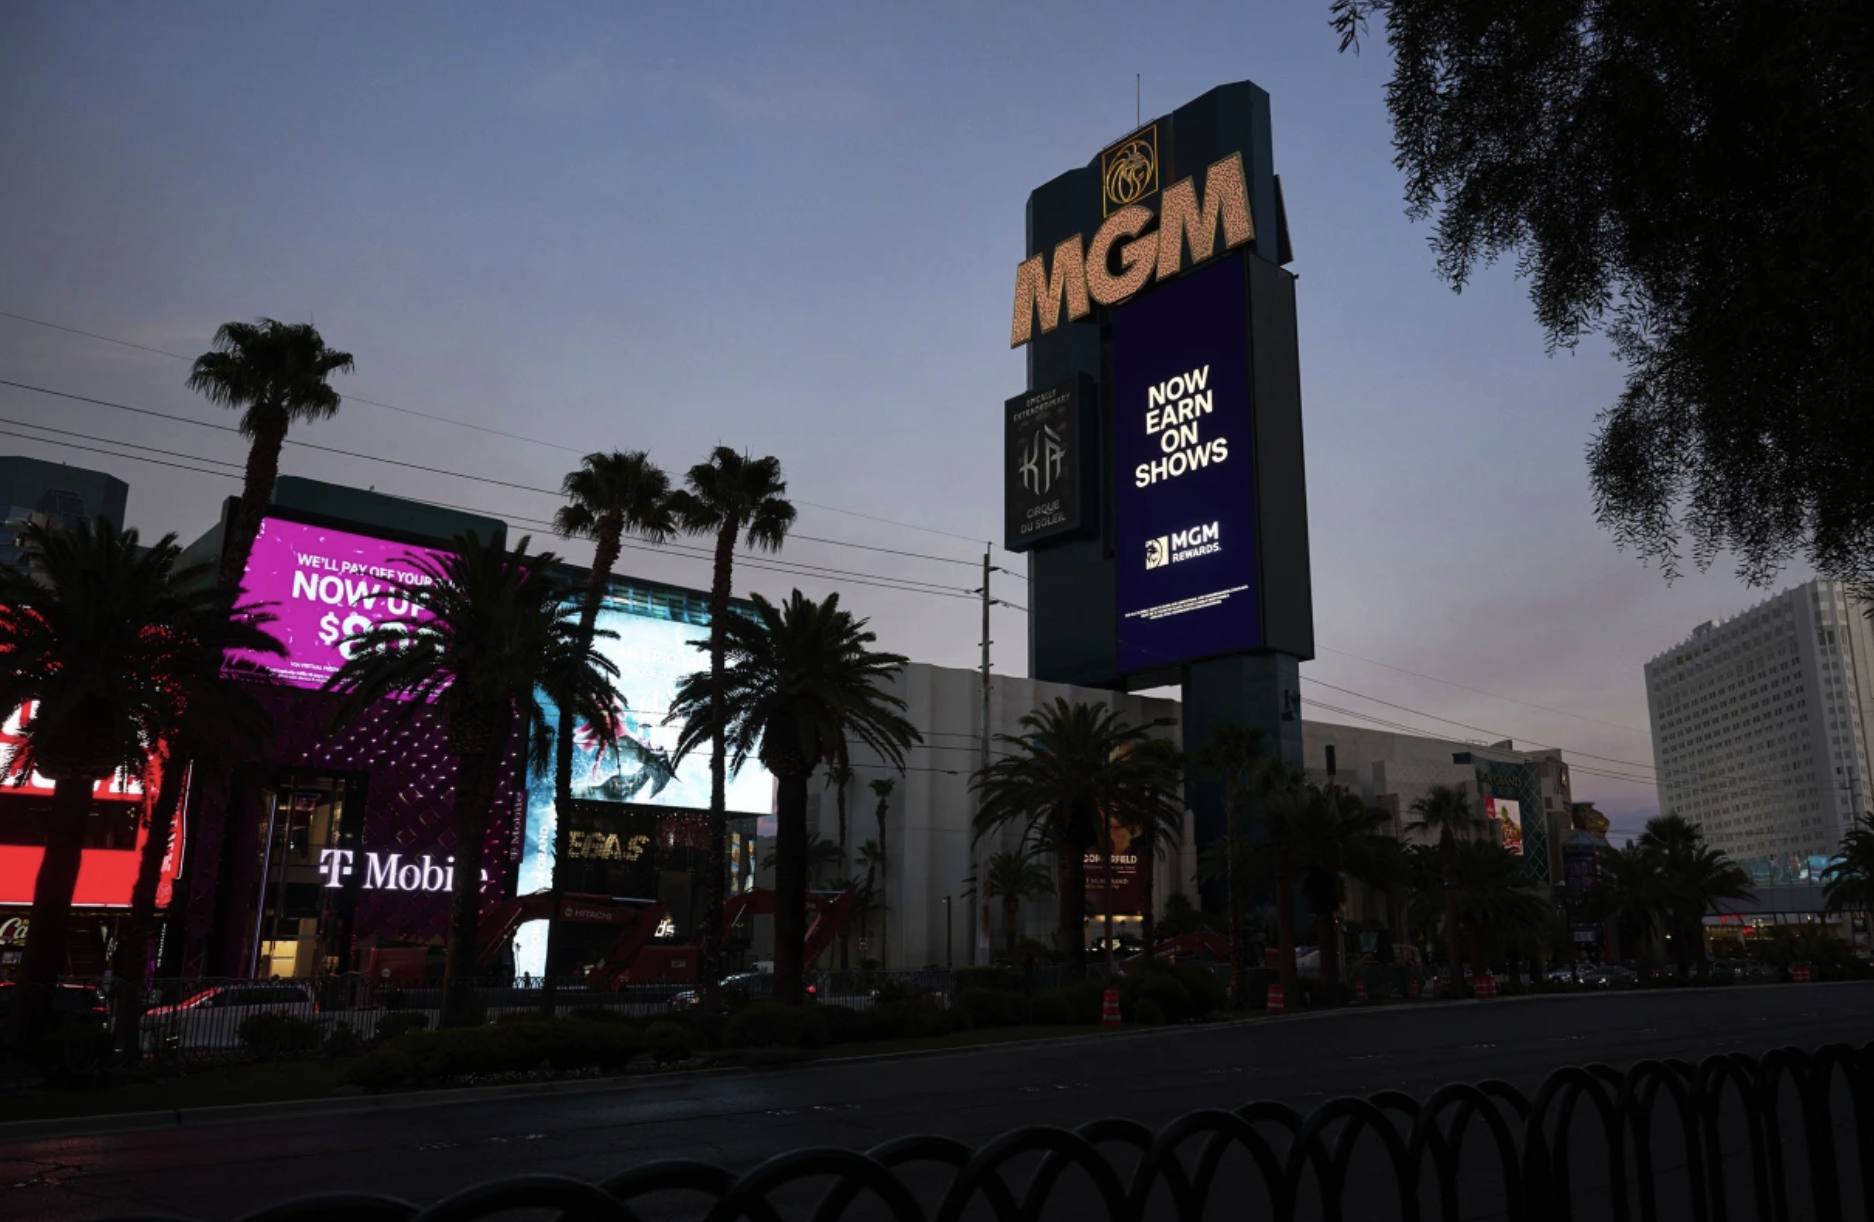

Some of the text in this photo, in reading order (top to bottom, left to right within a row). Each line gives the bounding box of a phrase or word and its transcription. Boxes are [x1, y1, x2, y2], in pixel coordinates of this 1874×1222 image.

[1011, 151, 1255, 349] MGM
[1148, 364, 1209, 409] NOW
[1146, 389, 1213, 435] EARN
[1161, 420, 1198, 453] ON
[1135, 437, 1228, 488] SHOWS
[1020, 515, 1067, 535] DU SOLEIL
[1026, 500, 1060, 519] CIRQUE
[1172, 520, 1219, 551] MGM
[297, 552, 339, 572] WE'LL
[341, 560, 369, 578] PAY
[369, 566, 395, 580] OFF
[292, 570, 381, 611] NOW
[511, 791, 524, 844] Mobile
[568, 830, 650, 862] EGAS
[319, 849, 354, 888] T
[362, 852, 488, 894] Mobi
[575, 908, 613, 921] HITACHI
